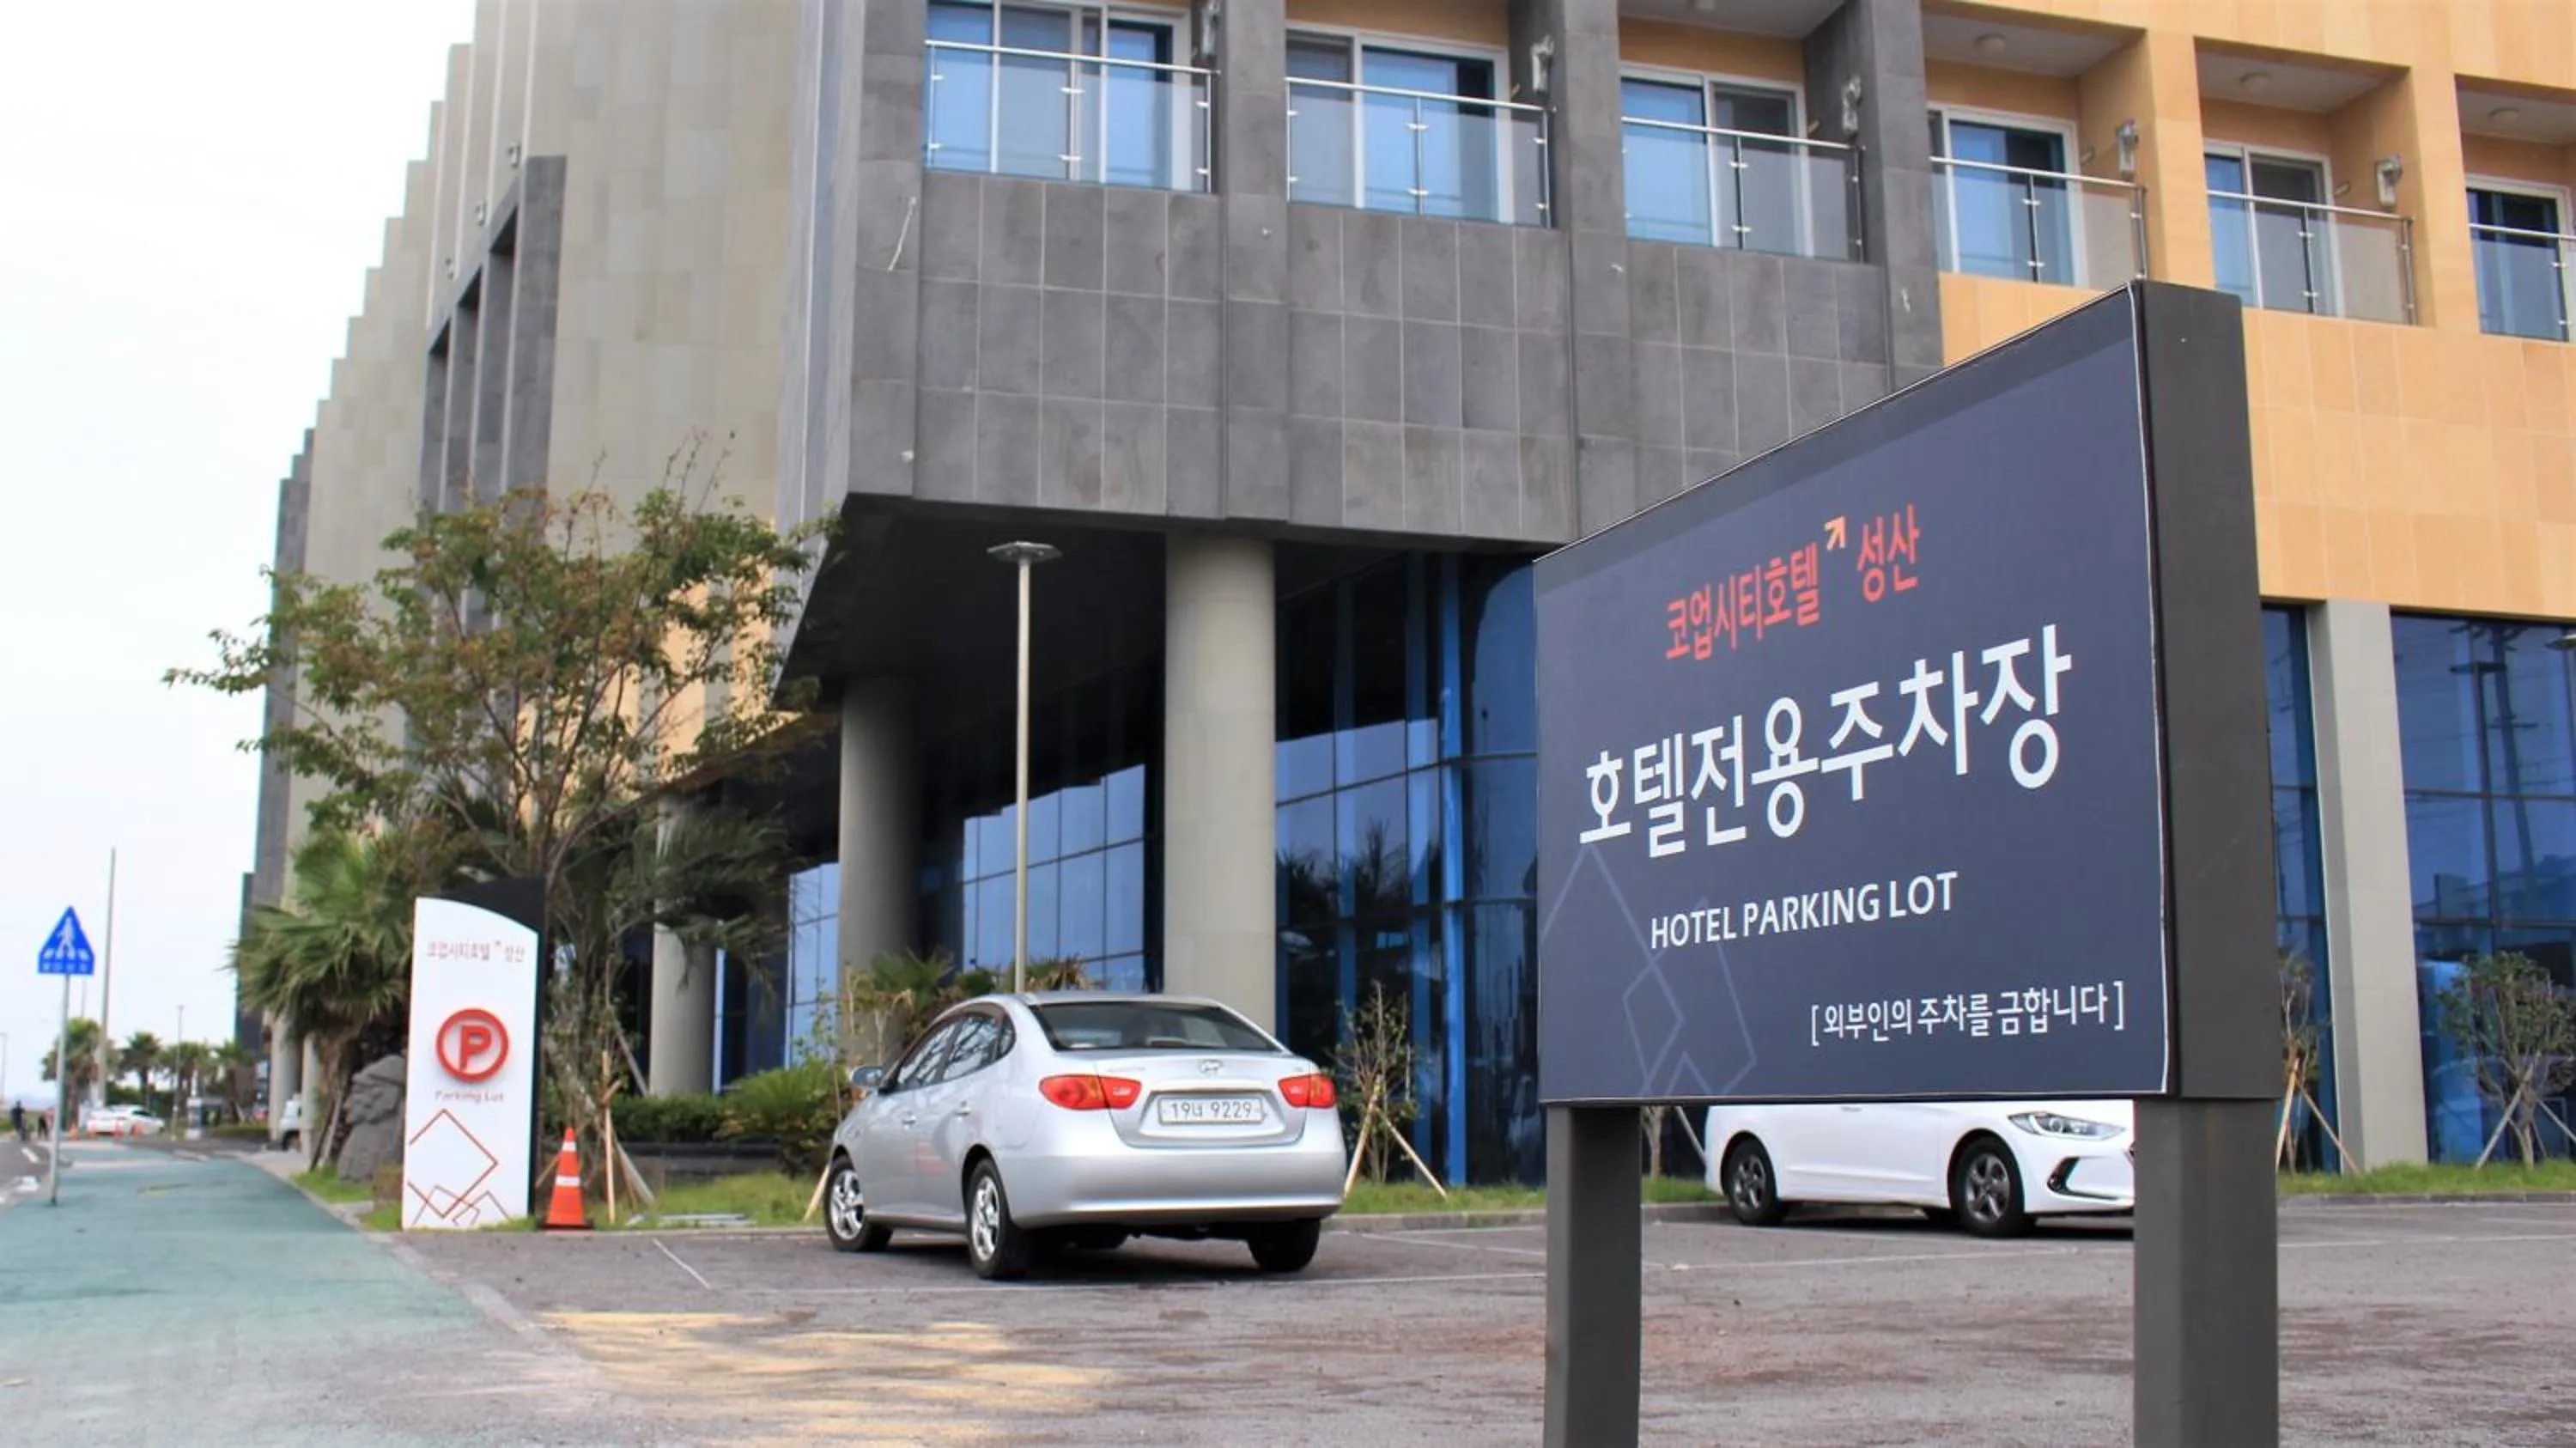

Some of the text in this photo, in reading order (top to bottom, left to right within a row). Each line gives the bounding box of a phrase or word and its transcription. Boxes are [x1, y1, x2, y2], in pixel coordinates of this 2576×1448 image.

[1666, 502, 1922, 660] 코업시티호텔 성산
[1580, 624, 2072, 858] 호텔전용주차장
[1650, 871, 1959, 950] HOTEL PARKING LOT
[1917, 993, 1994, 1037] 주차를
[459, 1024, 493, 1071] P
[1210, 1101, 1253, 1119] 9229
